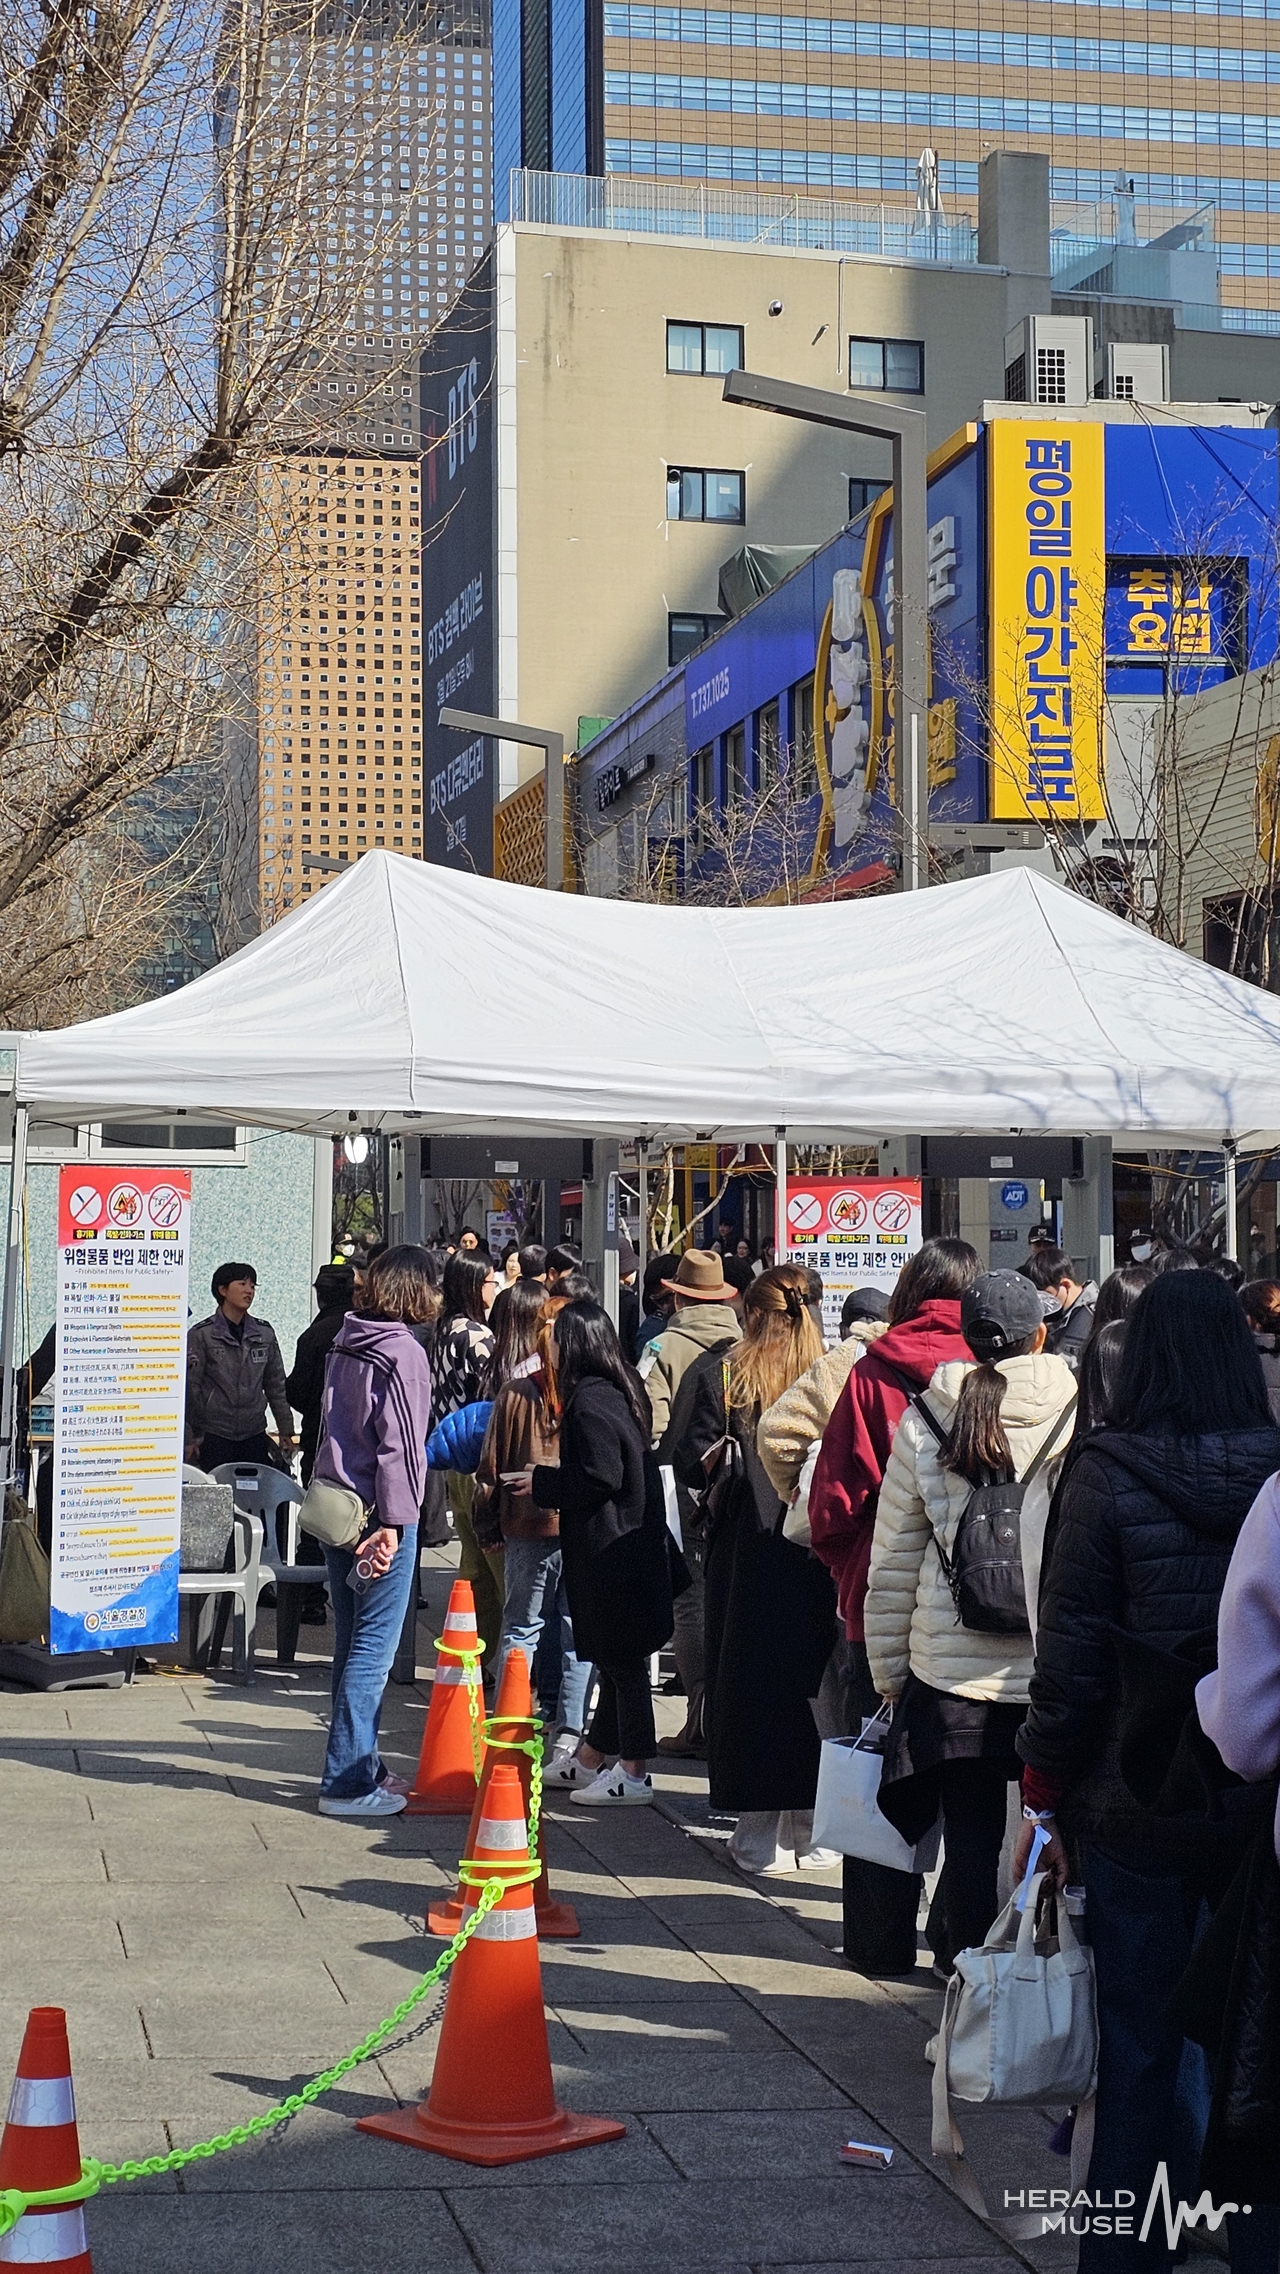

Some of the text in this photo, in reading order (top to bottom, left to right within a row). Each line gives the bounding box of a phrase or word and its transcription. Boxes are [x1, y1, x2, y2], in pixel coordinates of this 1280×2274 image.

[448, 356, 478, 481] BTS
[428, 571, 484, 666] BTS 컴백 라이브
[1024, 440, 1078, 802] 평일 야간진료
[691, 666, 730, 719] T.737.1025
[430, 736, 484, 815] BTS 다큐멘터리
[1005, 1190, 1025, 1201] ADT
[64, 1248, 184, 1266] 위험물품 반입 제한 안내
[135, 1267, 151, 1275] Public
[835, 1252, 858, 1268] 반입
[862, 1252, 887, 1268] 제한
[102, 1608, 145, 1622] 서울경찰청
